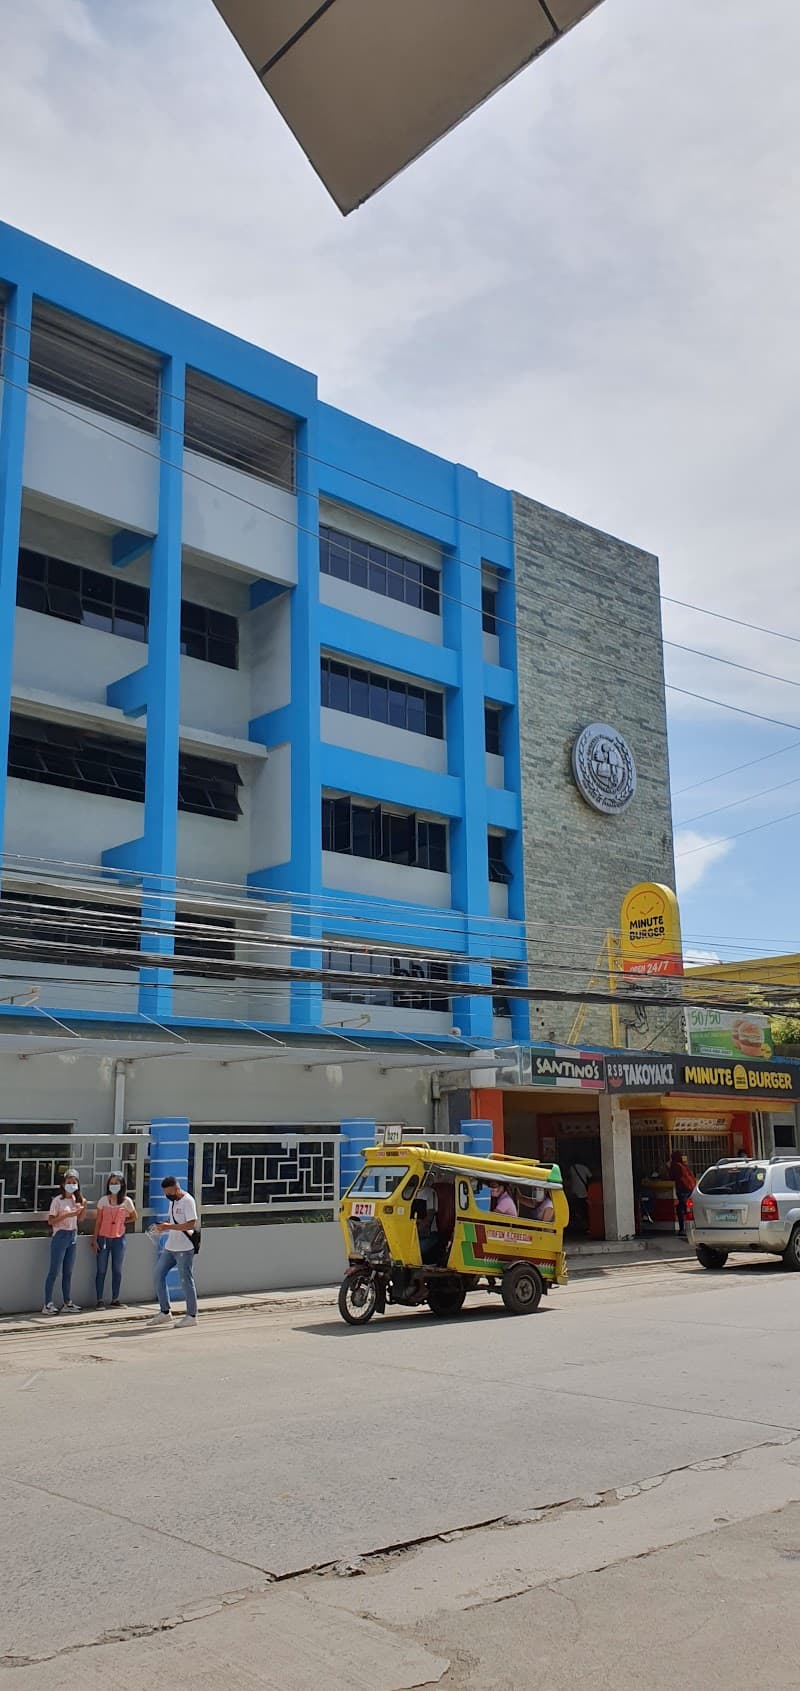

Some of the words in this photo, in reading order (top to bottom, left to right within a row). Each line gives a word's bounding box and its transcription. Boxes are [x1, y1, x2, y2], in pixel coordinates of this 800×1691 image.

[630, 916, 664, 929] MINUTE
[630, 927, 665, 940] BURGER
[536, 1058, 600, 1079] SANTINO'S
[623, 1064, 674, 1085] TAKOYAKI
[684, 1066, 733, 1086] MINUTE
[748, 1071, 793, 1090] BURGER
